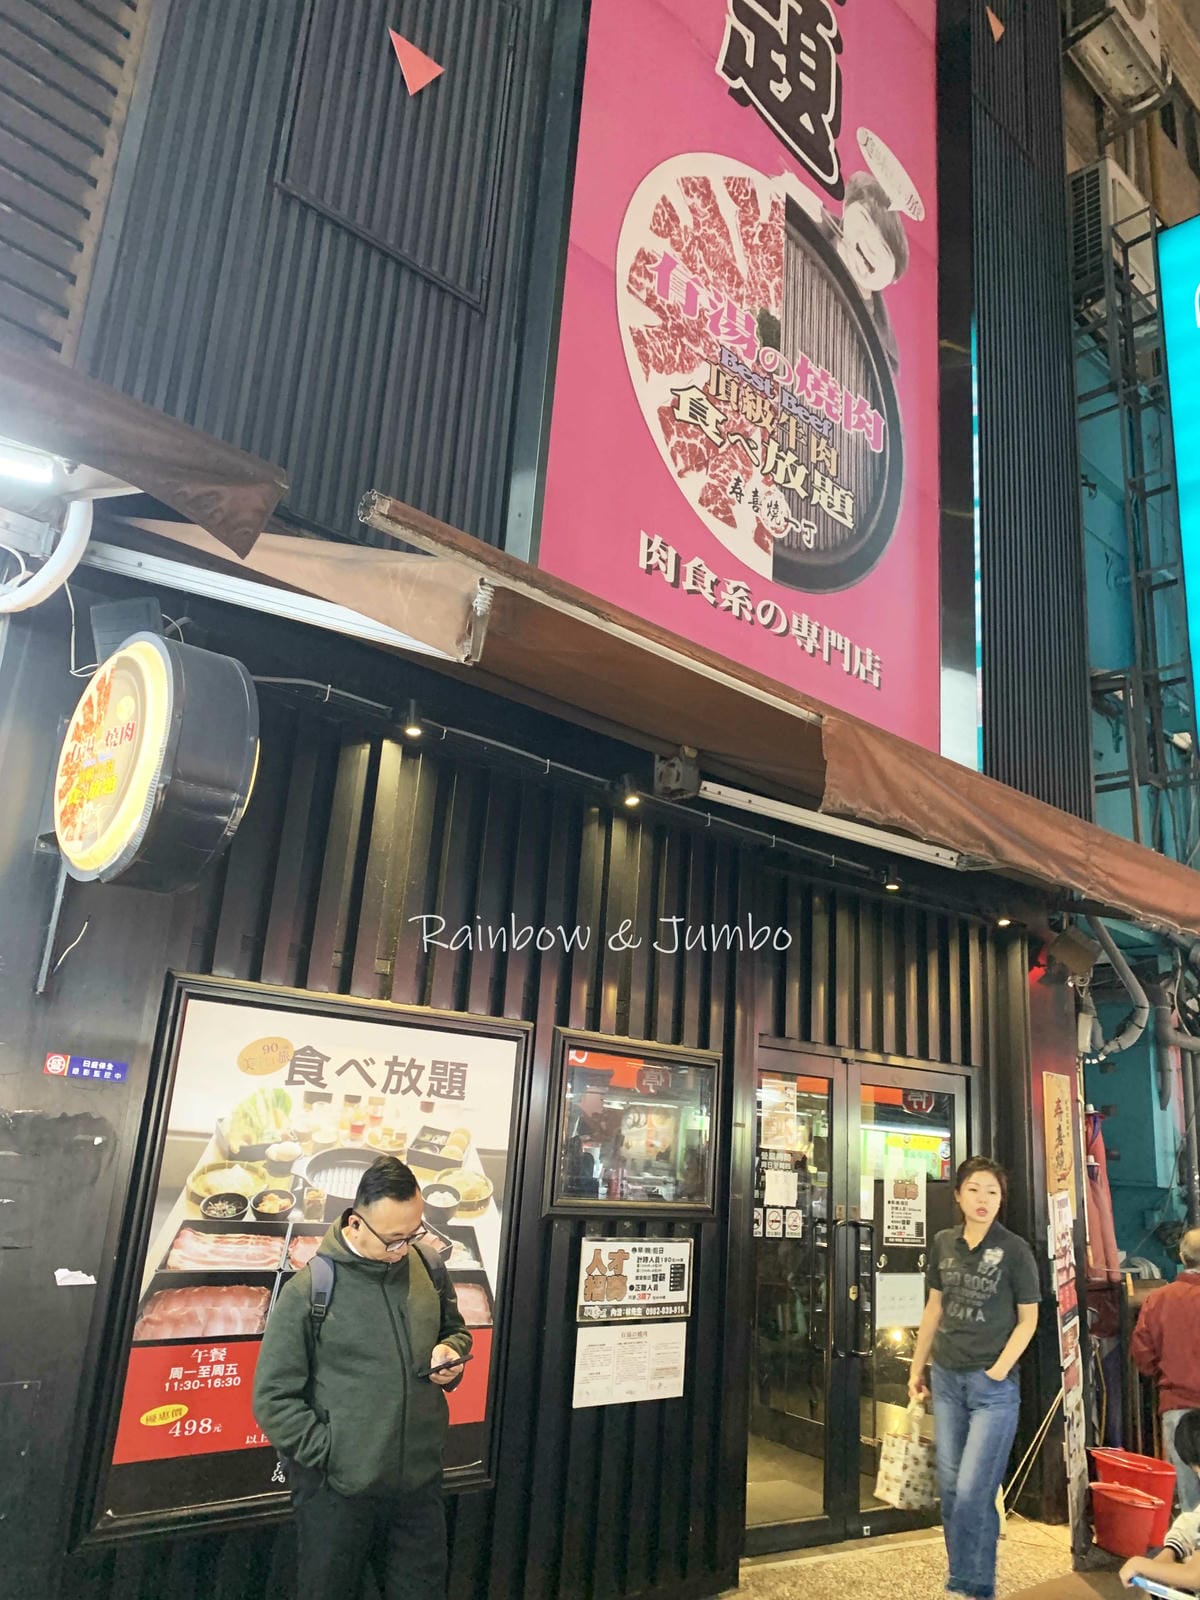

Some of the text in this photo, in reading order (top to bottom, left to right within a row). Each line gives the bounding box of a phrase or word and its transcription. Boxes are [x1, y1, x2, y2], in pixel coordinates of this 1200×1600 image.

[720, 345, 834, 438] Best Beef
[706, 358, 840, 478] 頂級牛肉
[670, 385, 855, 530] 食べ放題
[285, 1044, 469, 1101] 食べ放題
[963, 1272, 998, 1294] ROCK
[168, 1363, 239, 1380] 周一至周五
[191, 1347, 228, 1364] 午餐
[163, 1376, 241, 1392] 11:30-16:30
